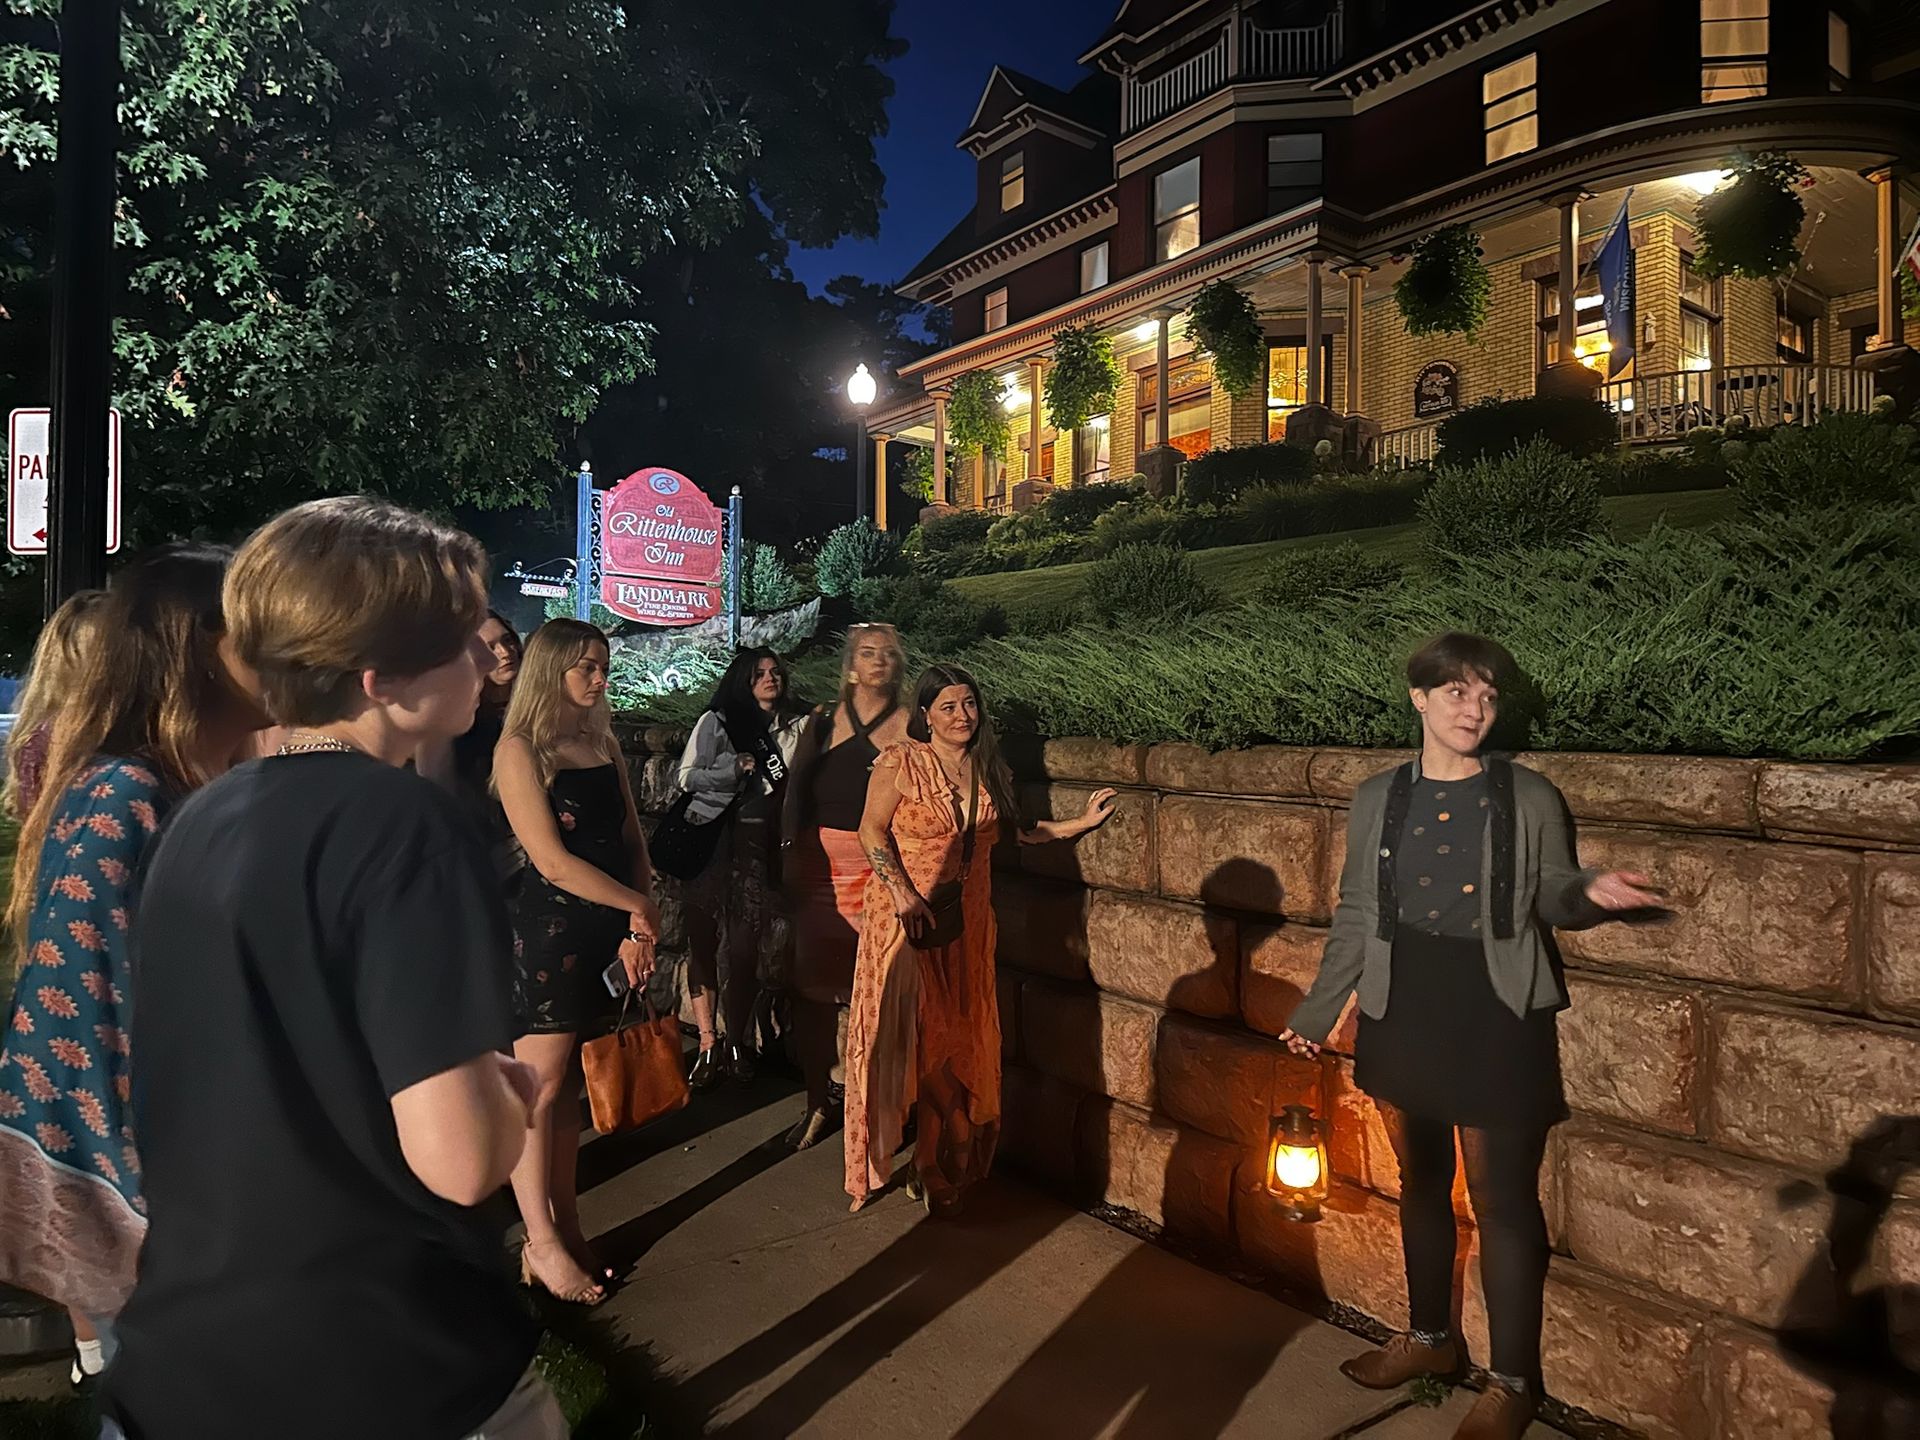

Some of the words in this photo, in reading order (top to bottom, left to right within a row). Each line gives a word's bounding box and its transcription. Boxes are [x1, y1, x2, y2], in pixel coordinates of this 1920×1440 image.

[19, 454, 49, 480] PA
[655, 504, 675, 518] Old
[608, 511, 718, 546] Rittenhouse
[644, 541, 685, 566] Inn
[615, 582, 713, 609] LANDMARK
[657, 609, 667, 617] &
[766, 754, 783, 781] Die
